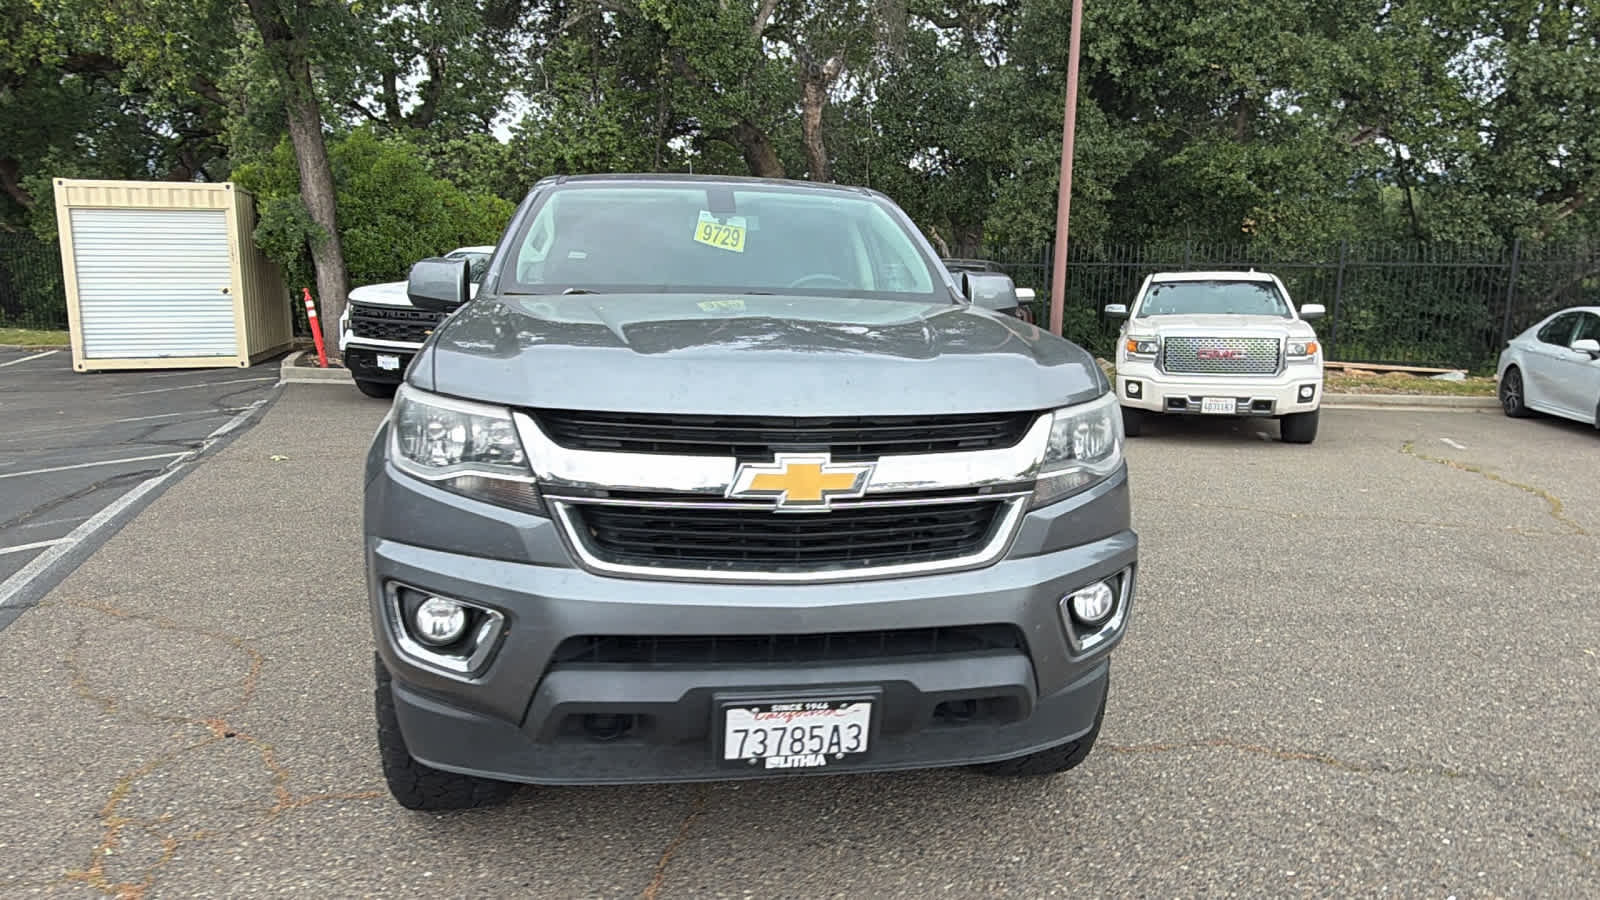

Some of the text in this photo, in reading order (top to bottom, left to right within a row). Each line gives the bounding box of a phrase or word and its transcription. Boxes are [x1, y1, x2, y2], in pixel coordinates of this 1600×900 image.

[702, 224, 740, 248] 9729
[771, 703, 803, 712] SINCE
[733, 723, 862, 758] 73785A3
[779, 754, 827, 768] LITHIA
